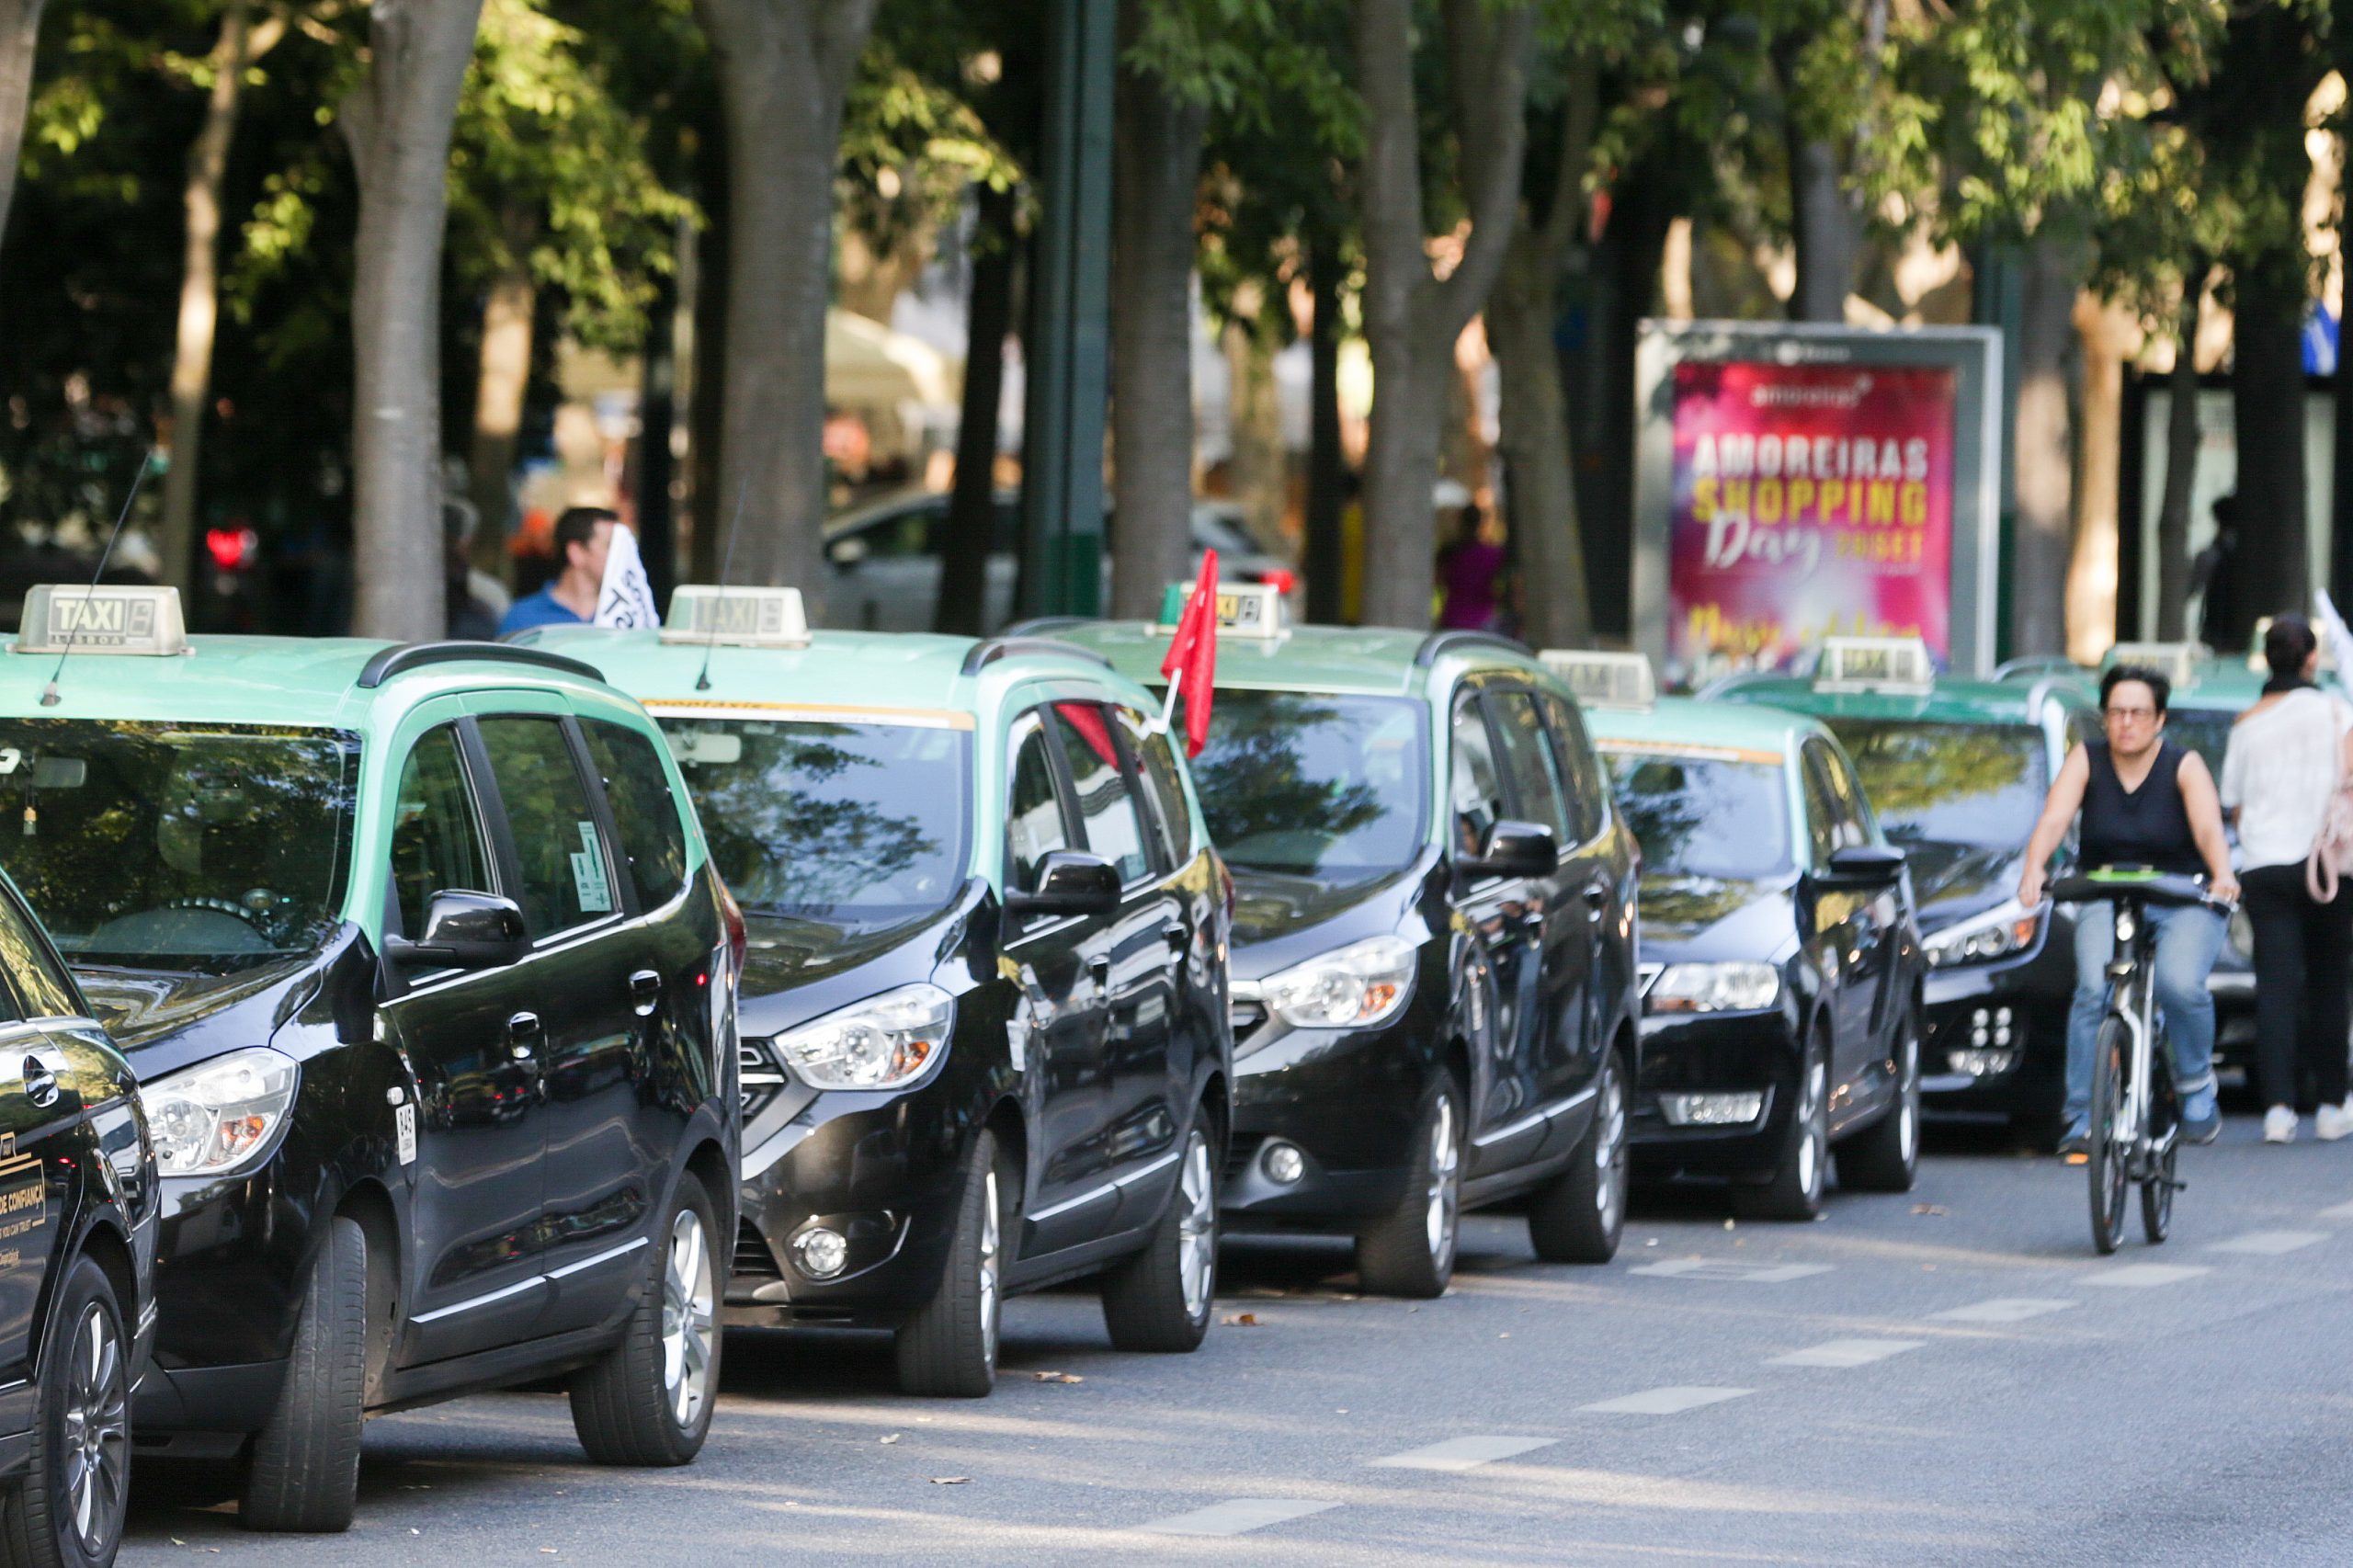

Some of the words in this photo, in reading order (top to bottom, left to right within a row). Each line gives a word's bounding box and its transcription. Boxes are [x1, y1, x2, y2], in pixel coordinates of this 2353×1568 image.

[1694, 435, 1927, 478] AMOREIRAS
[1693, 479, 1926, 524] SHOPPING
[1706, 509, 1819, 583] Day
[56, 599, 123, 631] TAXI
[699, 598, 756, 629] TAXI
[399, 1108, 412, 1136] 845
[8, 1184, 44, 1212] CONFIANÇA
